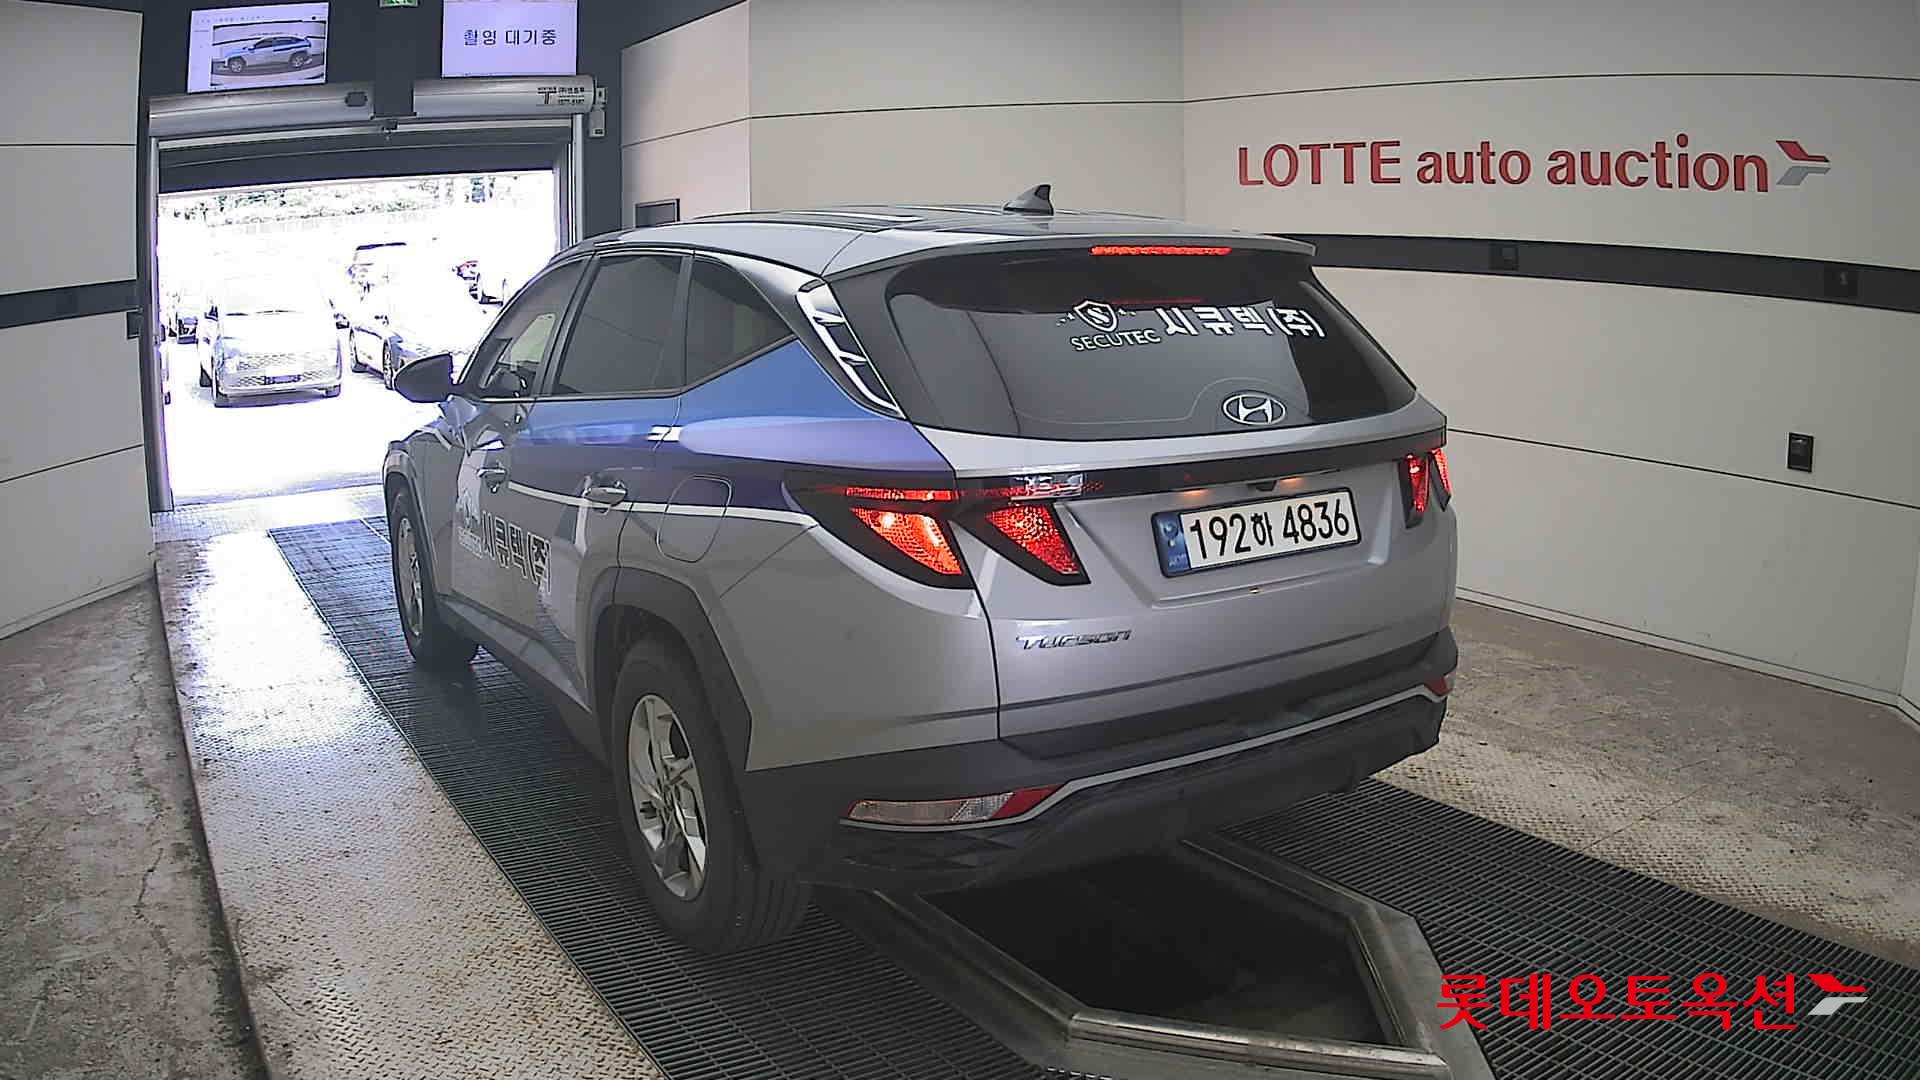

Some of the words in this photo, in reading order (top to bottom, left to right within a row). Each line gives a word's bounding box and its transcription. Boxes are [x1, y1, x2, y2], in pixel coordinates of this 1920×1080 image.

[505, 28, 557, 46] 대기중
[1238, 140, 1401, 187] LOTTE
[1417, 141, 1531, 186] auto
[1547, 133, 1770, 194] auction
[1070, 328, 1161, 352] SECUTEC
[1190, 511, 1274, 559] 192하
[1283, 499, 1350, 544] 4836
